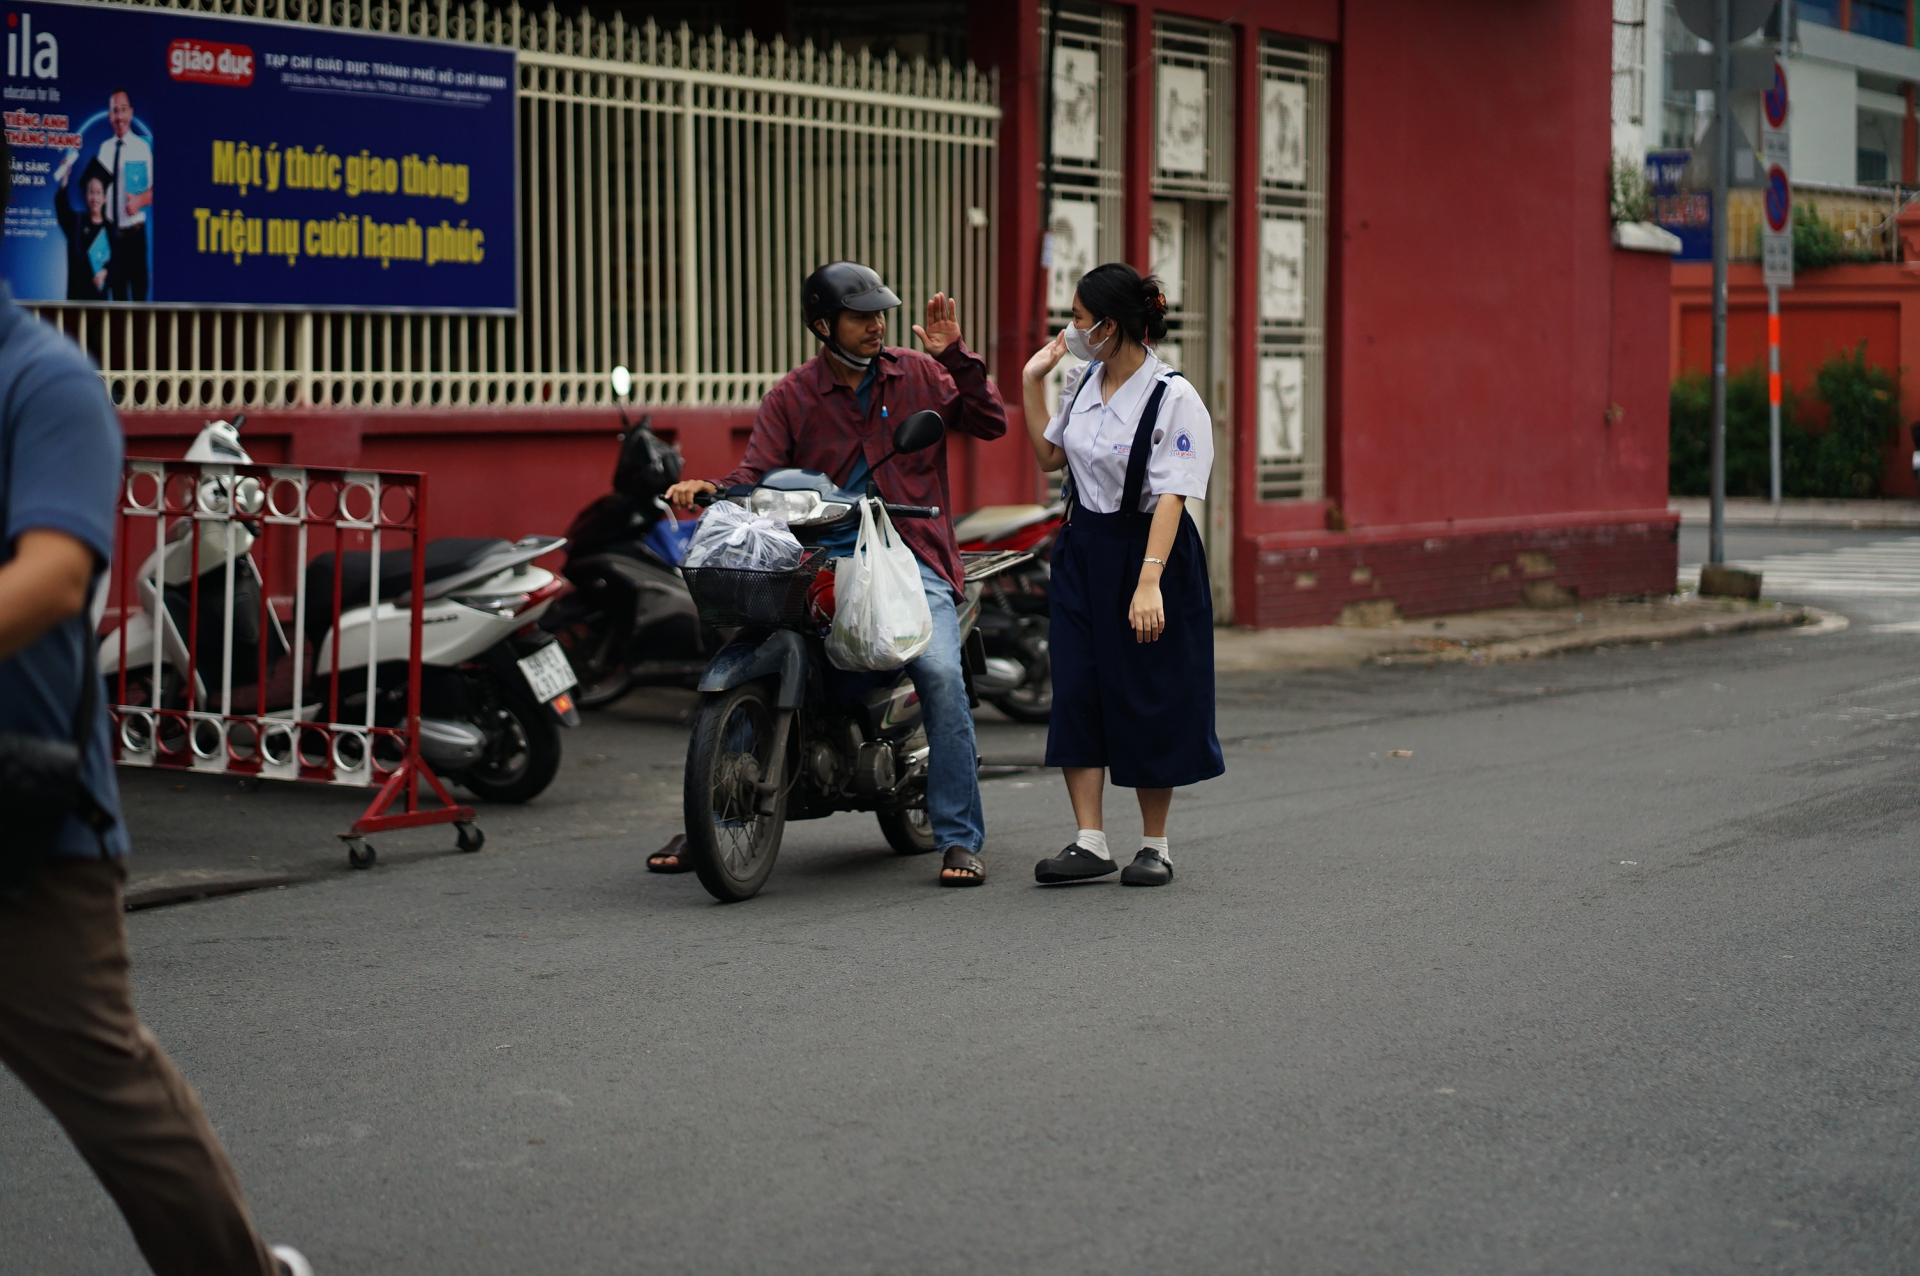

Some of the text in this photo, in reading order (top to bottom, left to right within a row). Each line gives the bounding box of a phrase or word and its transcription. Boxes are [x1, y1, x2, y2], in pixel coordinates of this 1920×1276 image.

[7, 12, 58, 79] ila
[170, 42, 253, 81] giáo dục
[264, 53, 288, 70] TẠP
[290, 55, 313, 70] CHÍ
[314, 56, 343, 72] GIÁO
[345, 60, 370, 76] DỤC
[372, 62, 411, 80] THÀNH
[412, 66, 436, 82] PHỐ
[437, 68, 454, 85] HỒ
[455, 71, 476, 87] CHÍ
[477, 75, 507, 90] MINH
[3, 108, 69, 131] TIẾNG ANH
[47, 133, 82, 152] HẠNG
[24, 159, 51, 173] SÀNG
[33, 175, 46, 186] XA
[212, 140, 470, 205] Một ý thức giao thông
[193, 207, 485, 269] Triệu nụ cười hạnh phúc
